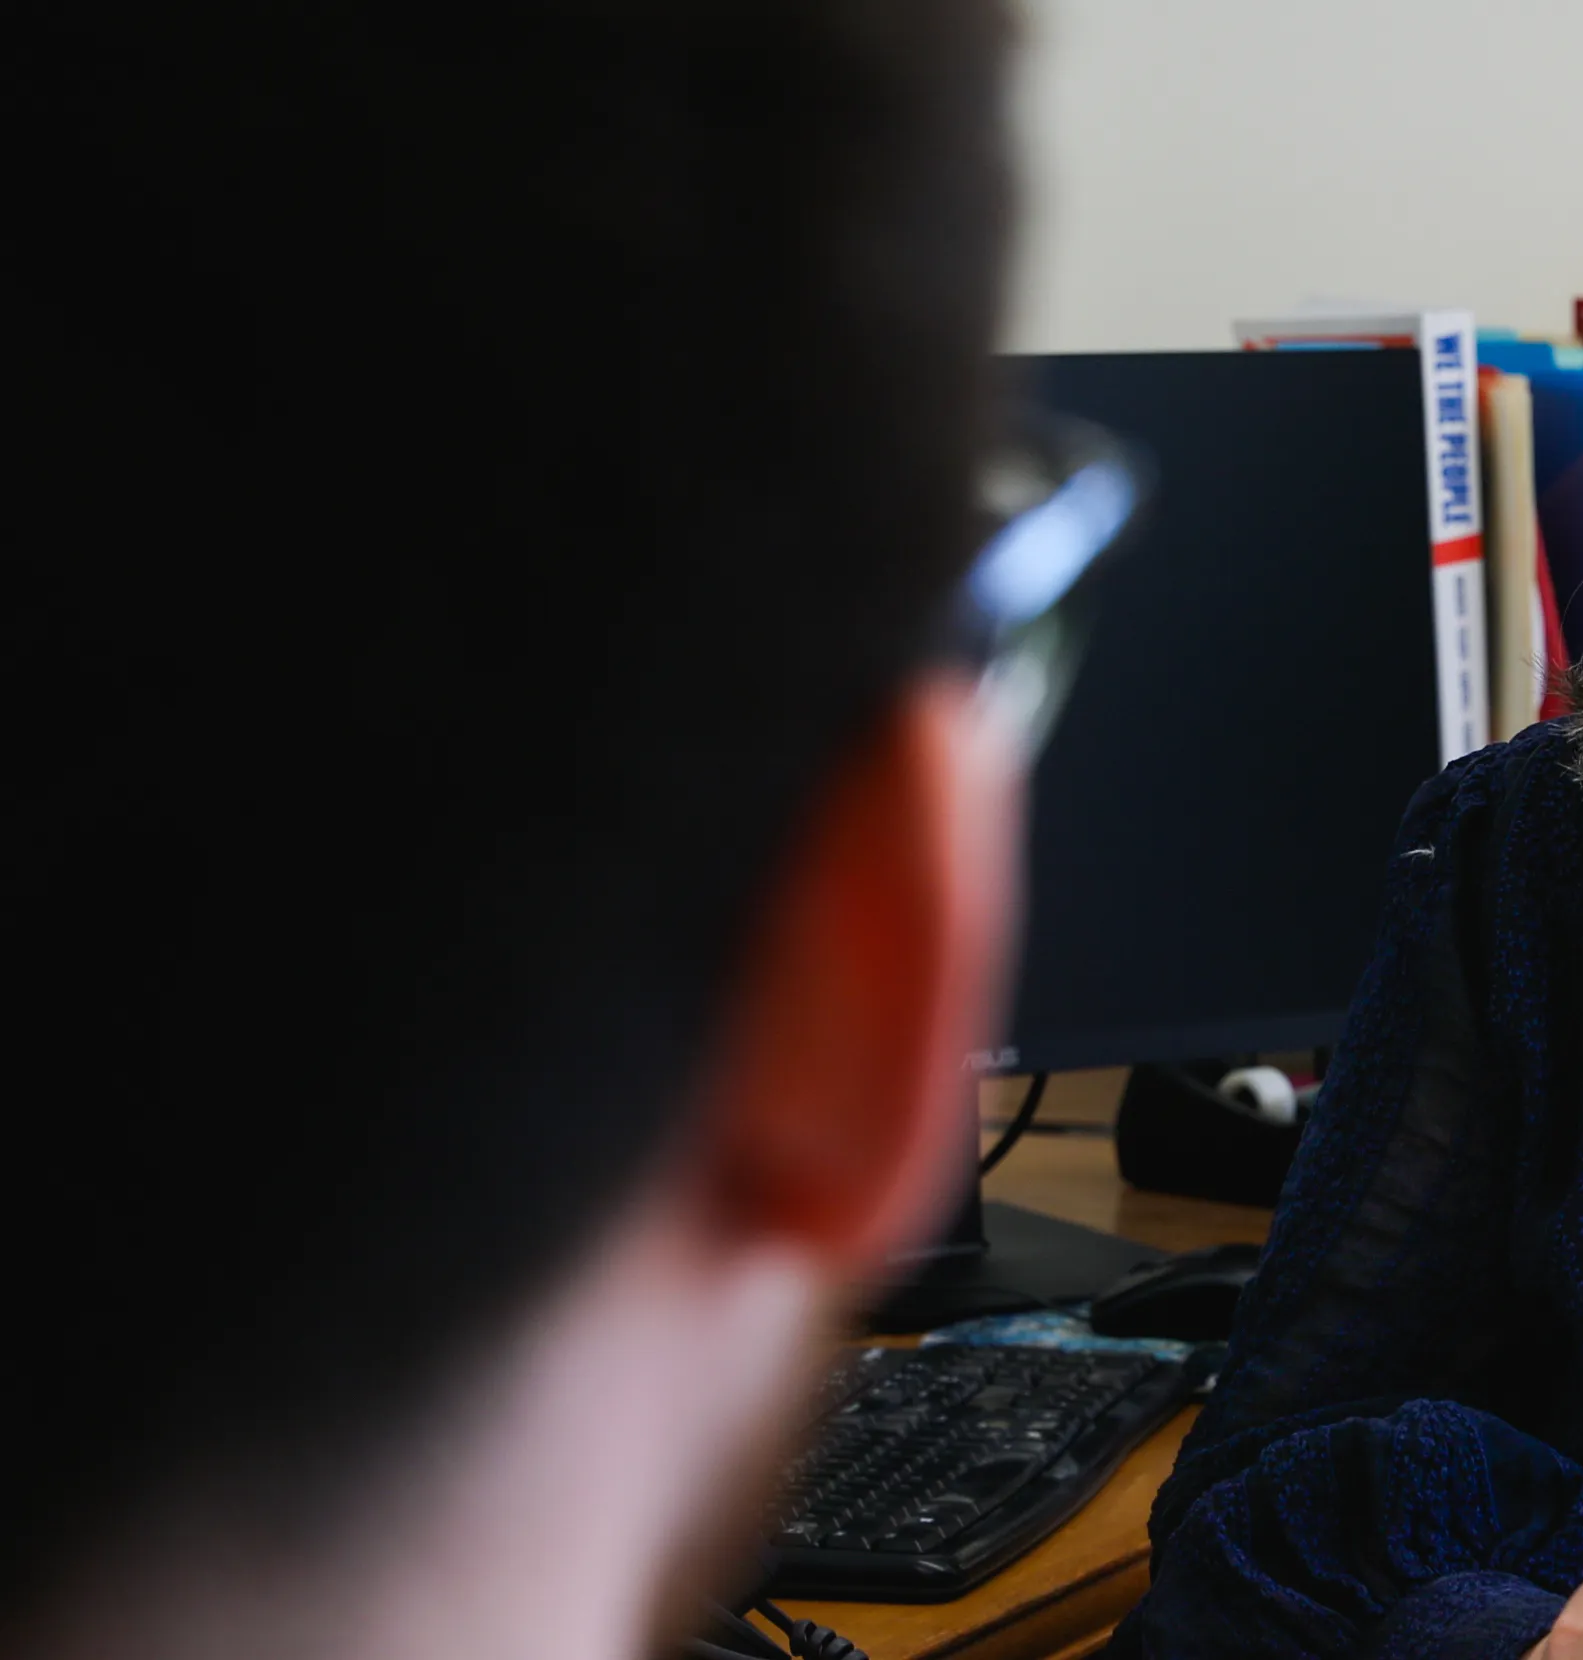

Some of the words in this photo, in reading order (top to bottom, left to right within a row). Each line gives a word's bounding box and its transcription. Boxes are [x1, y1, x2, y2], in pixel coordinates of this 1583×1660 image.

[1435, 332, 1463, 370] WE
[1437, 382, 1466, 423] THE
[1440, 432, 1472, 525] PEOPLE
